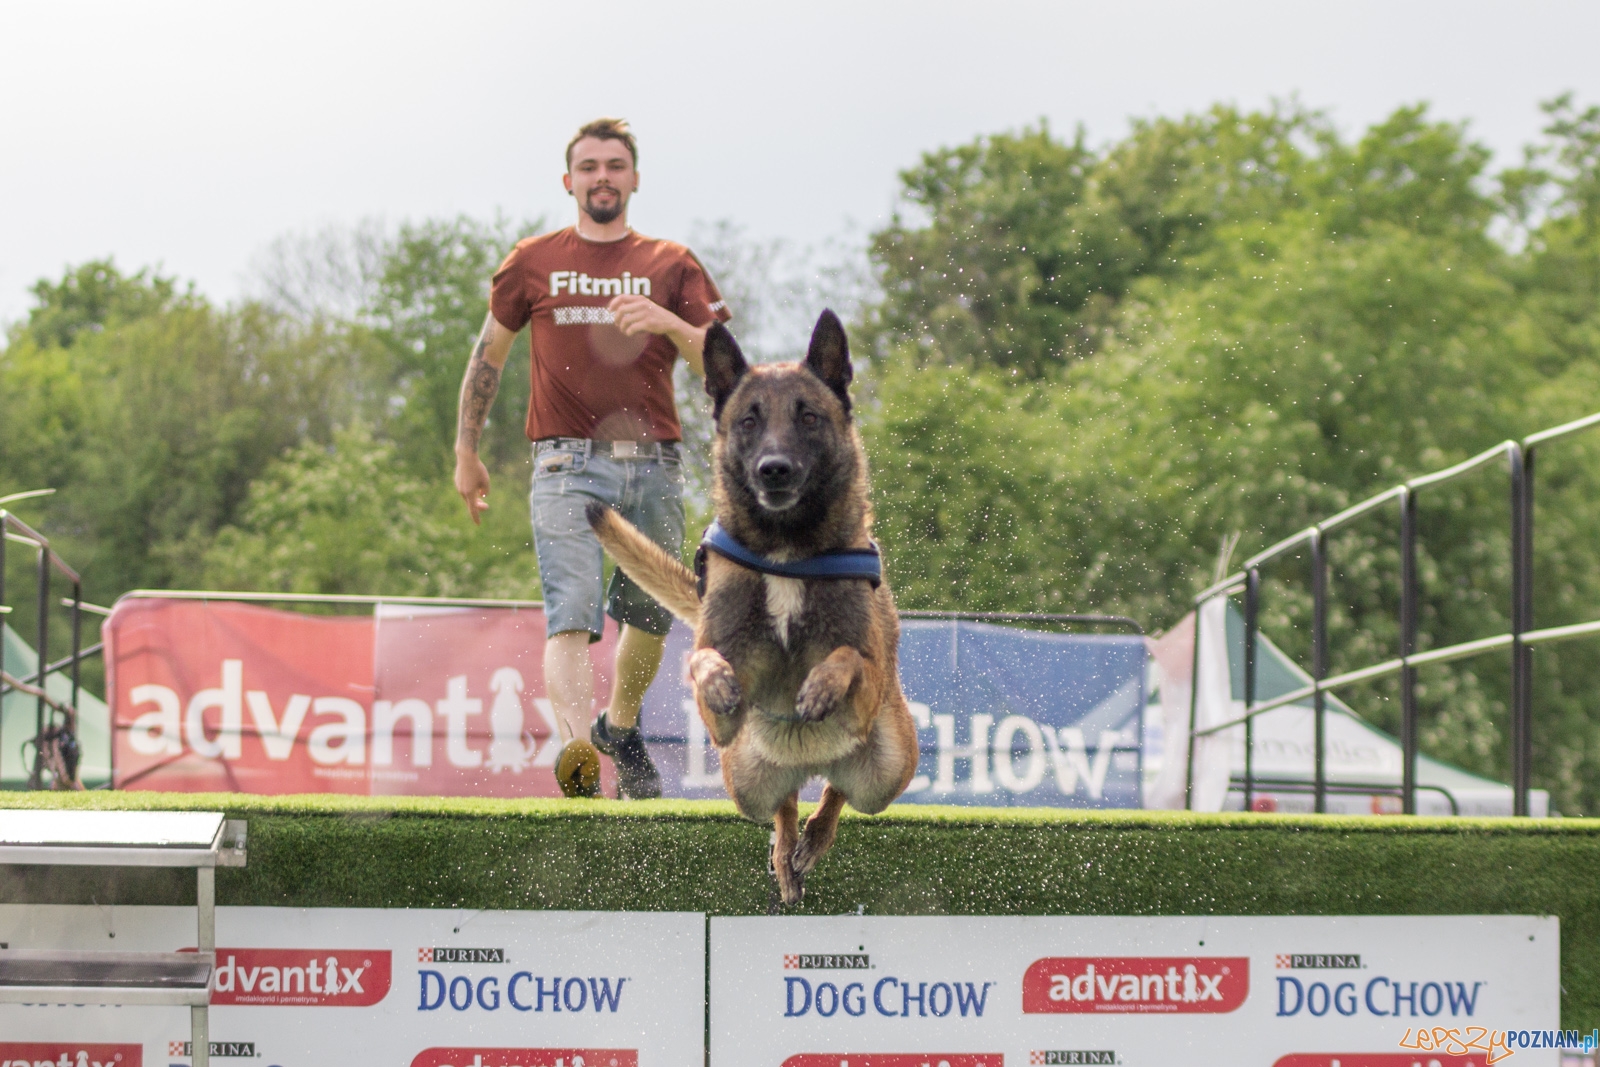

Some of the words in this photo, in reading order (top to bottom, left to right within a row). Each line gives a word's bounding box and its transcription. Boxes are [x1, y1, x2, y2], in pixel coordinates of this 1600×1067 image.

[550, 270, 651, 297] Fitmin
[434, 949, 503, 963] PURINA
[800, 955, 868, 968] PURINA
[1292, 955, 1360, 968] PURINA
[215, 955, 365, 995] dvantix
[417, 969, 501, 1011] DOG
[508, 971, 626, 1012] CHOW
[784, 977, 866, 1017] DOG
[874, 977, 990, 1017] CHOW
[1276, 976, 1358, 1017] DOG
[1365, 976, 1481, 1017] CHOW
[186, 1042, 253, 1056] PRINA
[1047, 1051, 1113, 1064] PURINA
